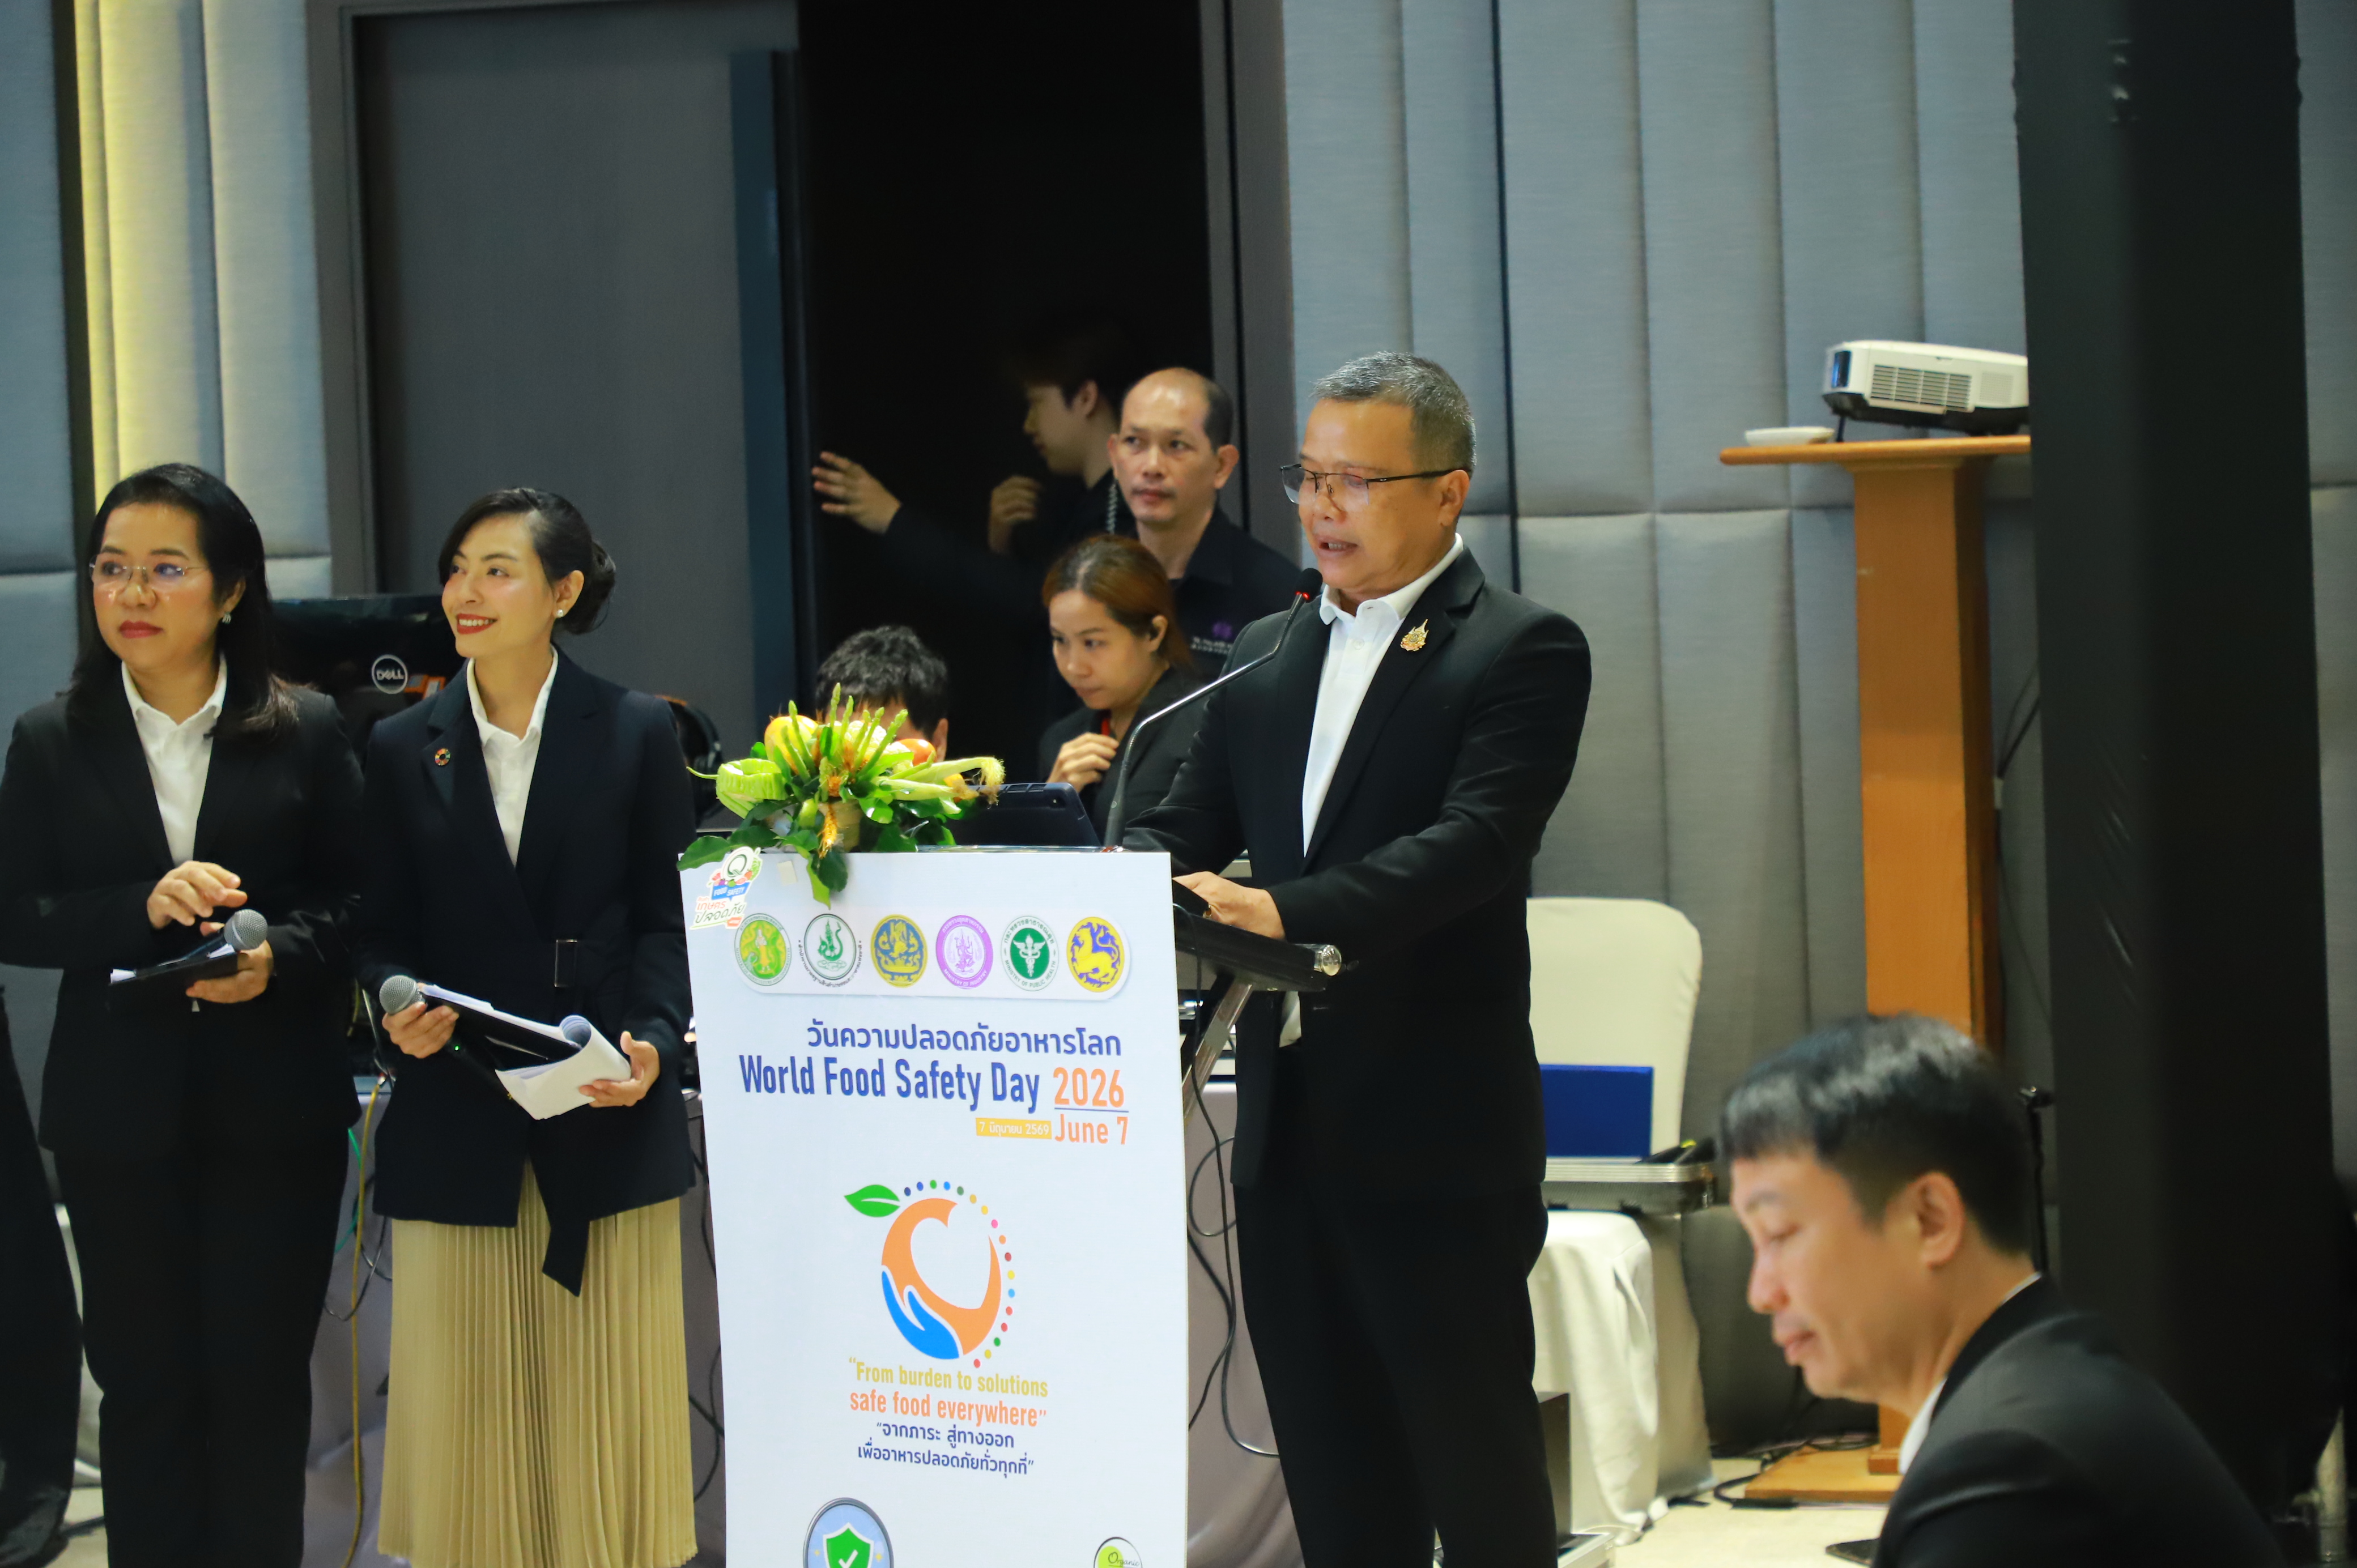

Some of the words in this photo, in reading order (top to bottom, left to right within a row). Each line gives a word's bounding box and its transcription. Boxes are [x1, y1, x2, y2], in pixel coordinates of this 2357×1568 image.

[376, 669, 404, 680] DELL
[714, 887, 727, 896] FOOD
[726, 887, 745, 896] SAFETY
[695, 902, 746, 923] ปลอดภัย
[697, 901, 726, 910] เกษตร
[1004, 919, 1054, 944] กระทรวงสาธารณสุข
[944, 969, 963, 986] MINISTRY
[969, 970, 987, 986] INDUSTRY
[1005, 960, 1020, 983] MINISTRY
[1029, 979, 1046, 988] PUBLIC
[1045, 961, 1056, 981] HEALTH
[807, 1019, 1121, 1056] วันความปลอดภัยอาหารโลก
[739, 1055, 815, 1094] World
[824, 1057, 886, 1097] Food
[895, 1059, 981, 1111] Safety
[991, 1062, 1040, 1114] Day
[1053, 1067, 1124, 1107] 2026
[979, 1122, 985, 1133] 7
[989, 1122, 1023, 1137] มิถุนายน
[1026, 1123, 1050, 1135] 2569
[1054, 1114, 1109, 1143] June
[1117, 1117, 1128, 1145] 7
[849, 1357, 894, 1383] “From
[899, 1366, 952, 1388] burden
[957, 1371, 972, 1391] to
[978, 1374, 1048, 1397] solutions
[850, 1390, 887, 1413] safe
[893, 1391, 930, 1417] food
[938, 1400, 1046, 1426] everywhere”
[947, 1424, 1014, 1448] สู่ทางออก
[1108, 1552, 1139, 1567] Organic
